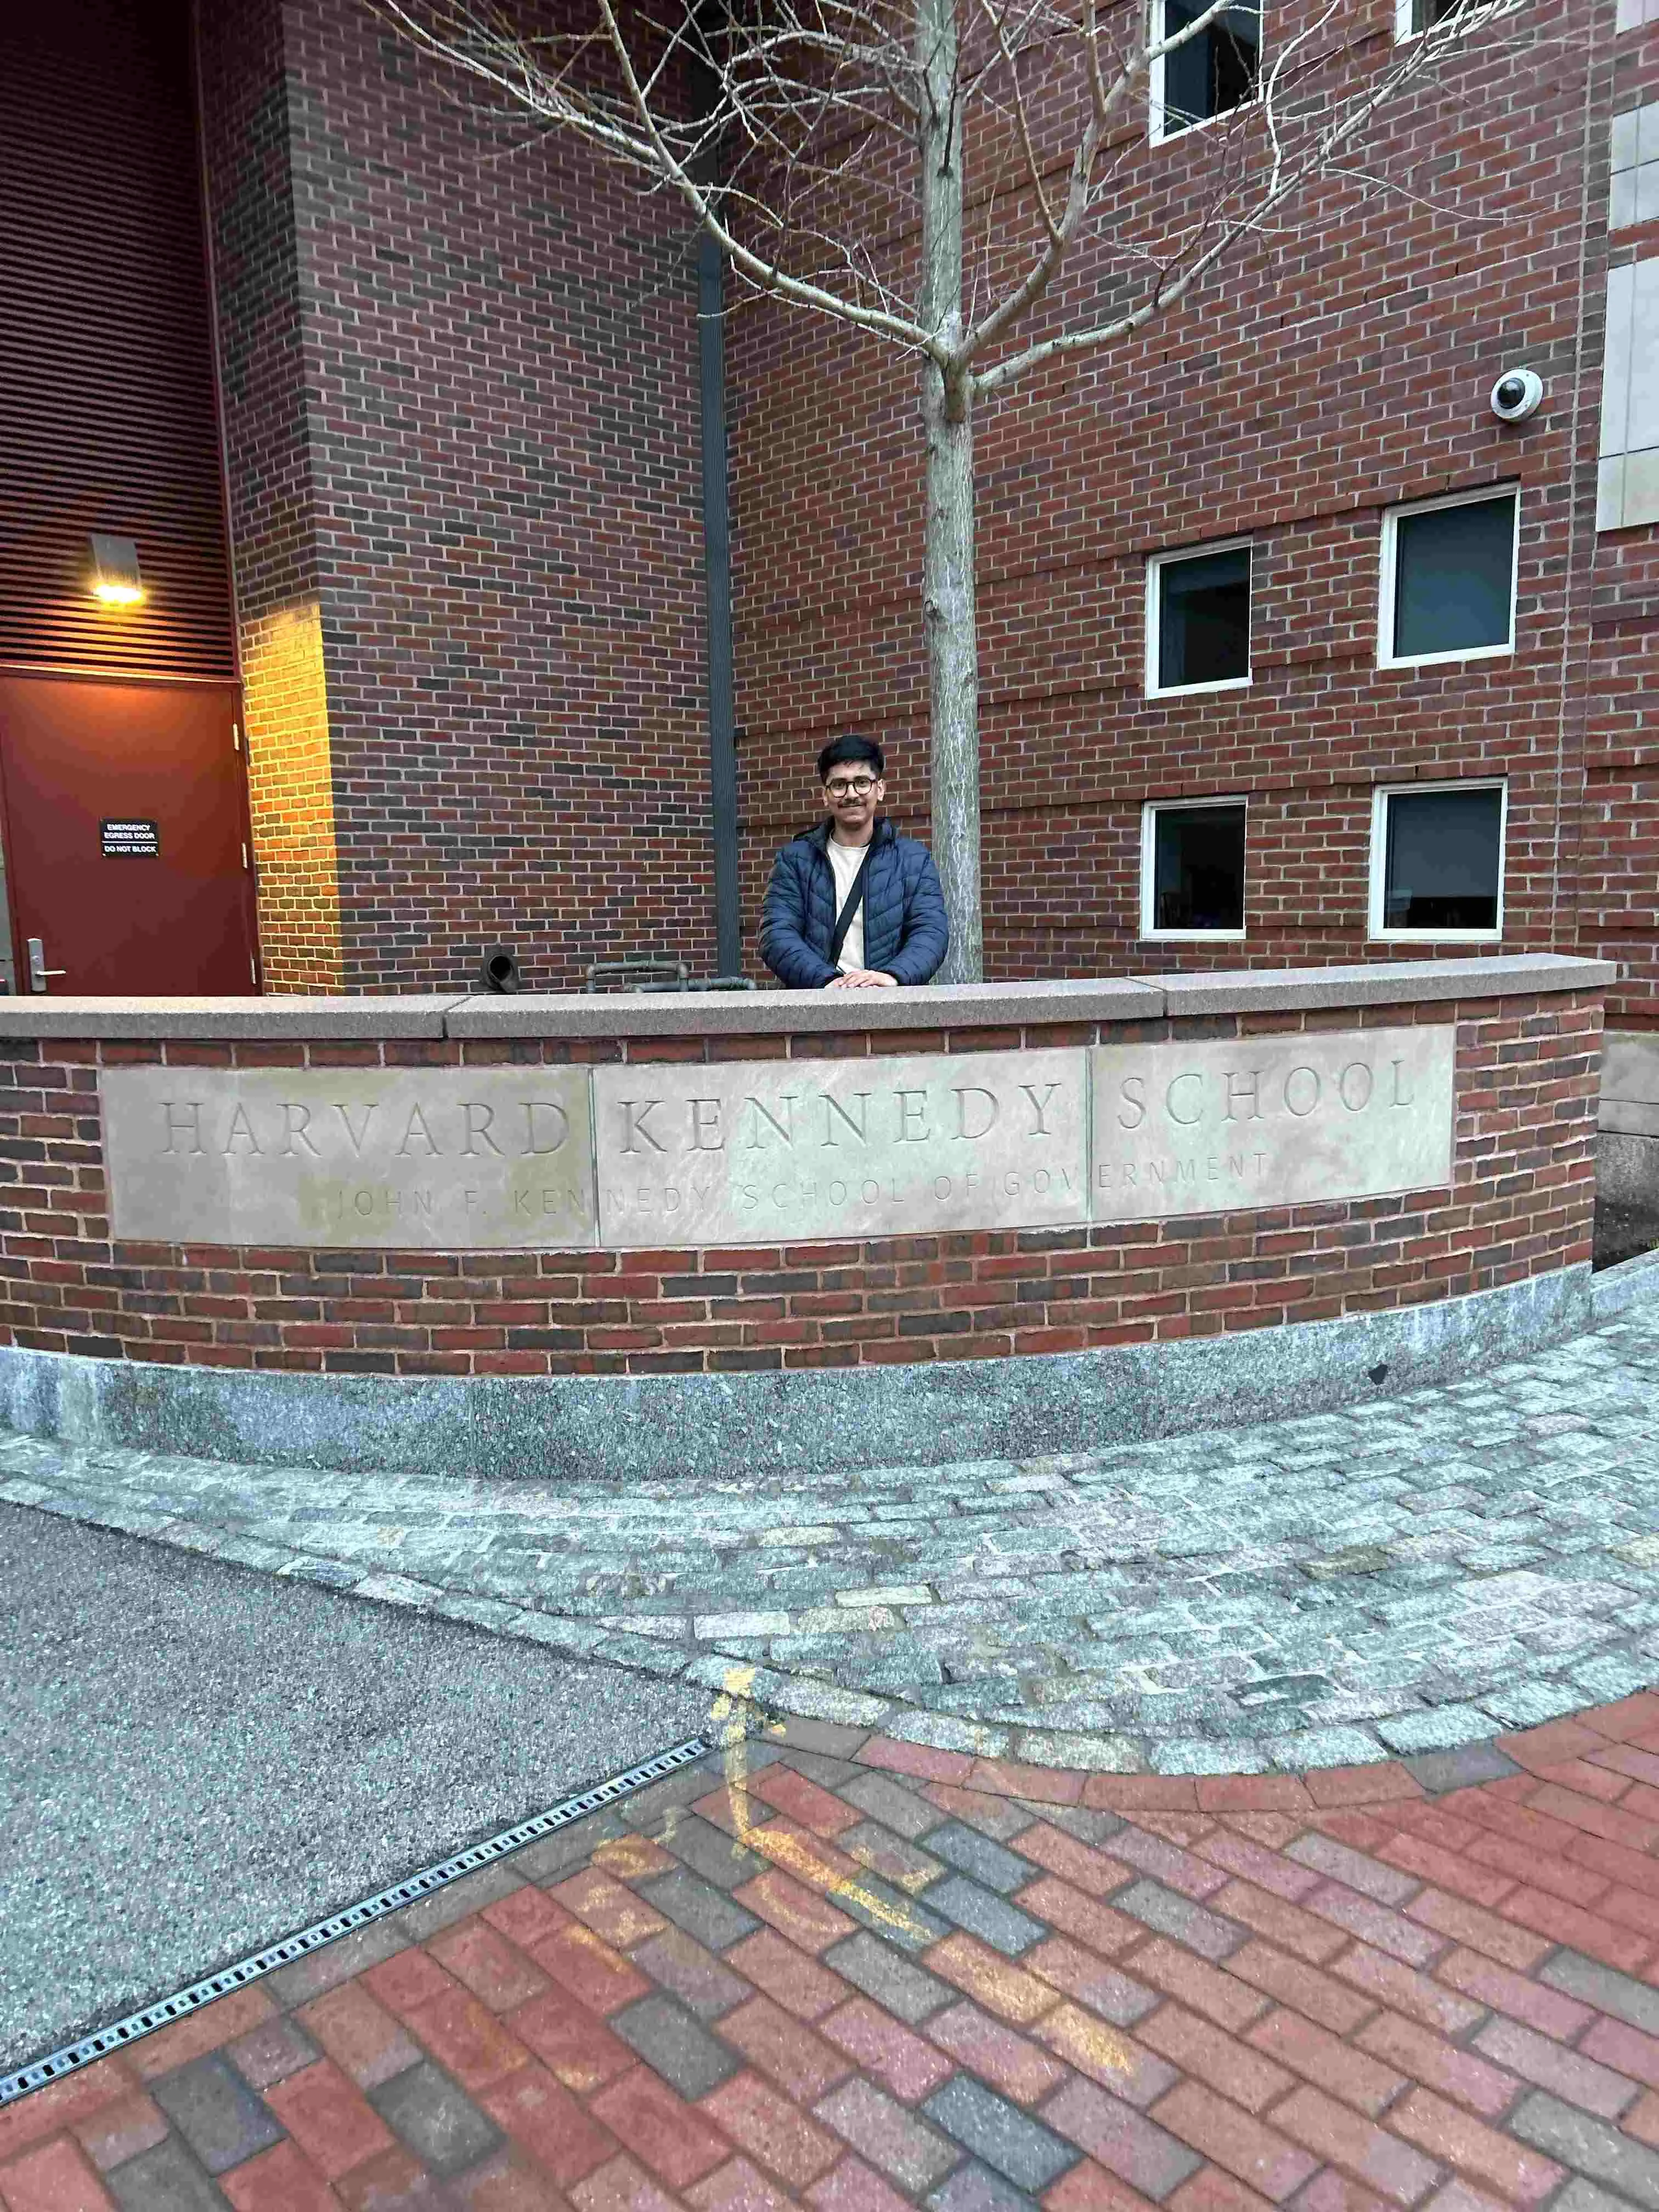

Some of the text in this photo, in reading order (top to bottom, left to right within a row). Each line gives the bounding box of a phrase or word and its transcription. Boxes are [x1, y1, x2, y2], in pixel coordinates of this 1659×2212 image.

[160, 1060, 1414, 1157] HARVARD KENNEDY SCHOOL
[338, 1153, 1267, 1218] JOHN F. KENNEDY SCHOOL OF GOVERNMENT
